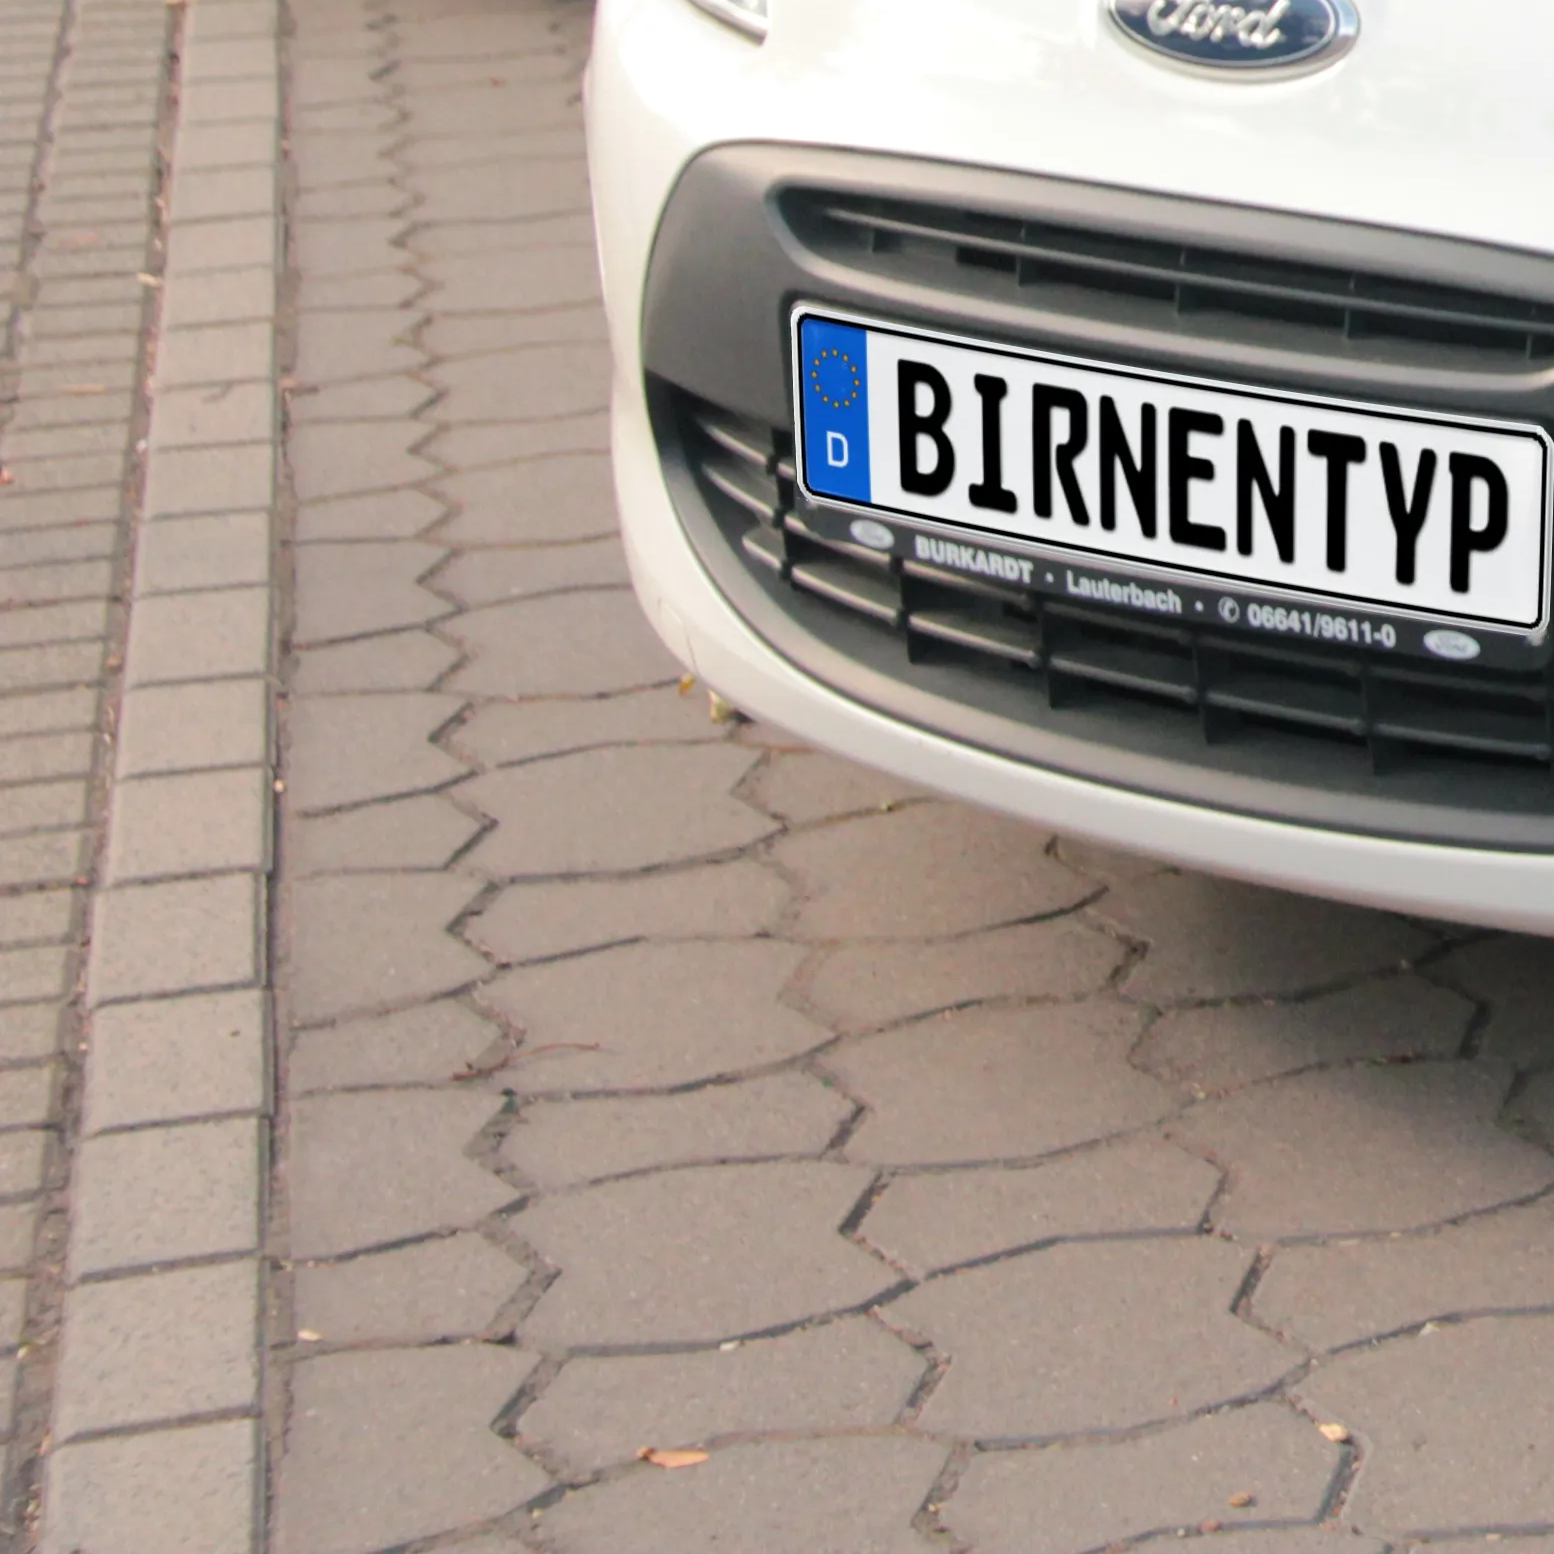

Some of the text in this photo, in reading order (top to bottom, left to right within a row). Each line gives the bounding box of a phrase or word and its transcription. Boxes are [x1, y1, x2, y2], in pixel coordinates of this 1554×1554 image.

[826, 430, 849, 468] D
[897, 358, 1509, 594] BIRNENTYP
[914, 534, 1034, 584] BURKARDT
[1066, 569, 1182, 614] Lauterbach
[1246, 602, 1397, 649] 06641/9611-0
